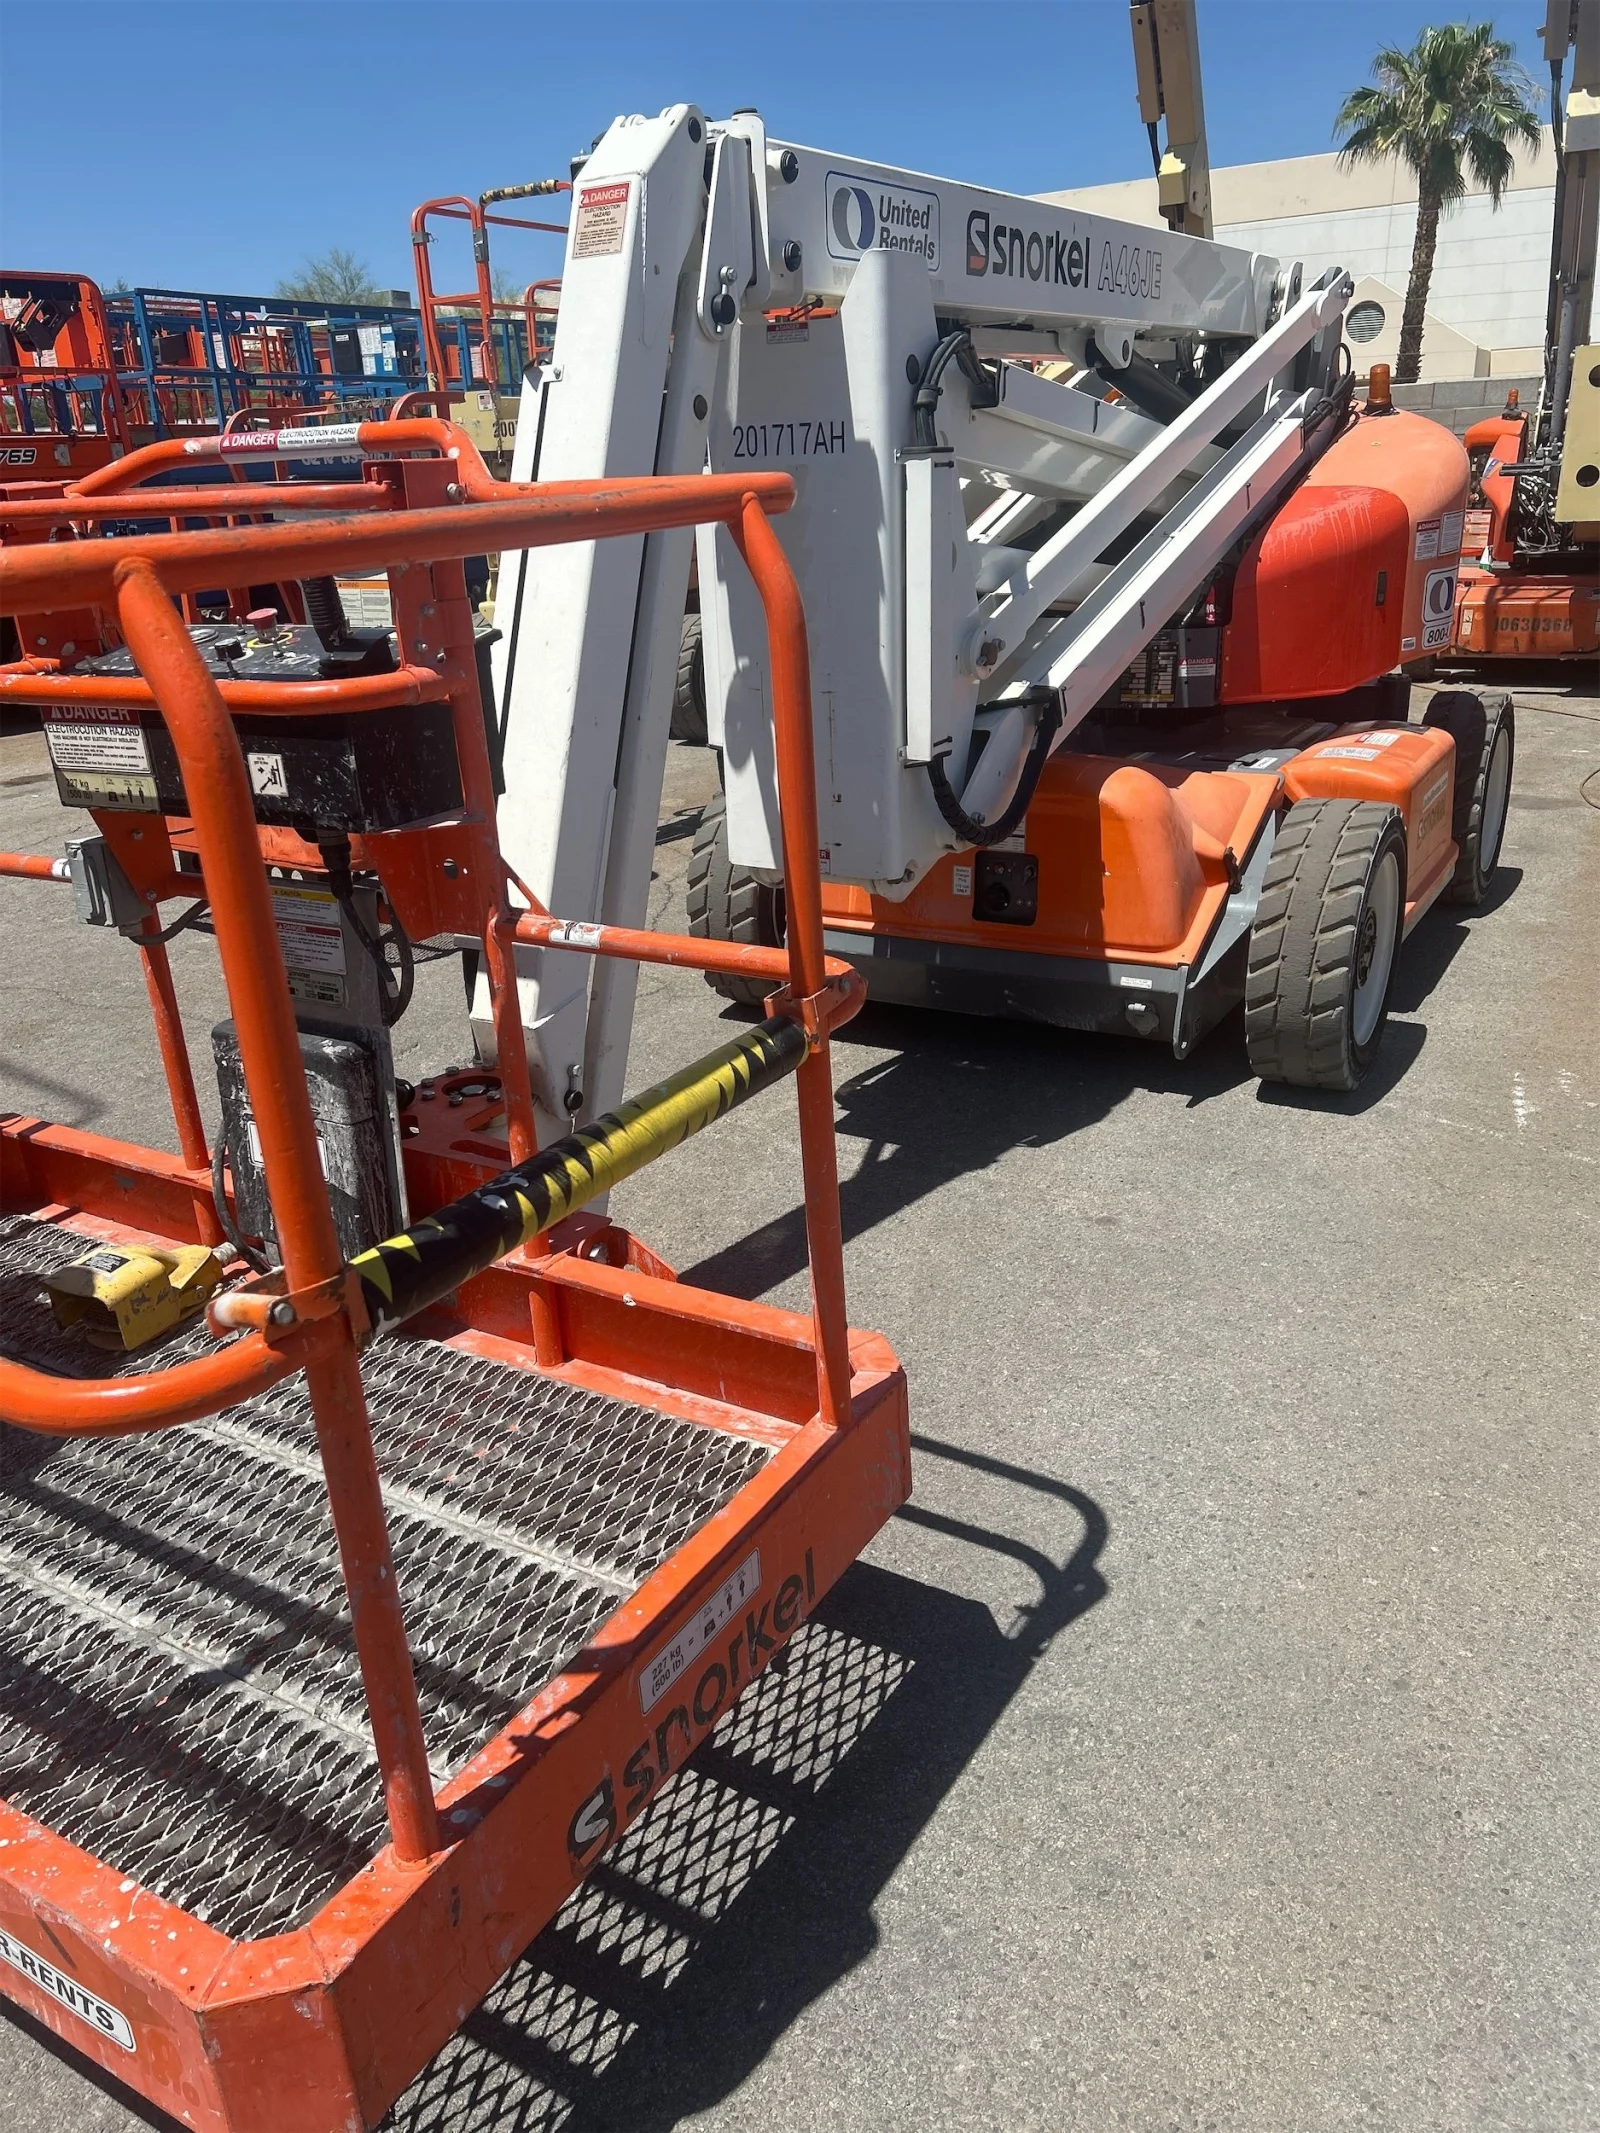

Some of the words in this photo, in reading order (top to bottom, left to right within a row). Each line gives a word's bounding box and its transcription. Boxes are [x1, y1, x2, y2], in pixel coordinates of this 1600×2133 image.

[590, 188, 626, 201] DANGER
[879, 195, 931, 230] United
[878, 226, 936, 261] Rentals
[991, 222, 1091, 289] snorkel
[1097, 240, 1164, 300] A46JE
[232, 433, 275, 447] DANGER
[279, 429, 329, 438] ELECTROCUTION
[733, 421, 845, 458] 201717AH
[63, 706, 130, 720] DANGER
[48, 725, 107, 735] ELECTROCUTION
[110, 727, 139, 736] HAZARD
[79, 778, 90, 791] kg
[282, 923, 307, 932] DANGER
[651, 1656, 668, 1681] 227
[669, 1644, 682, 1661] kg
[622, 1546, 816, 1817] snorkel
[651, 1668, 671, 1697] (500
[672, 1653, 684, 1673] lb)
